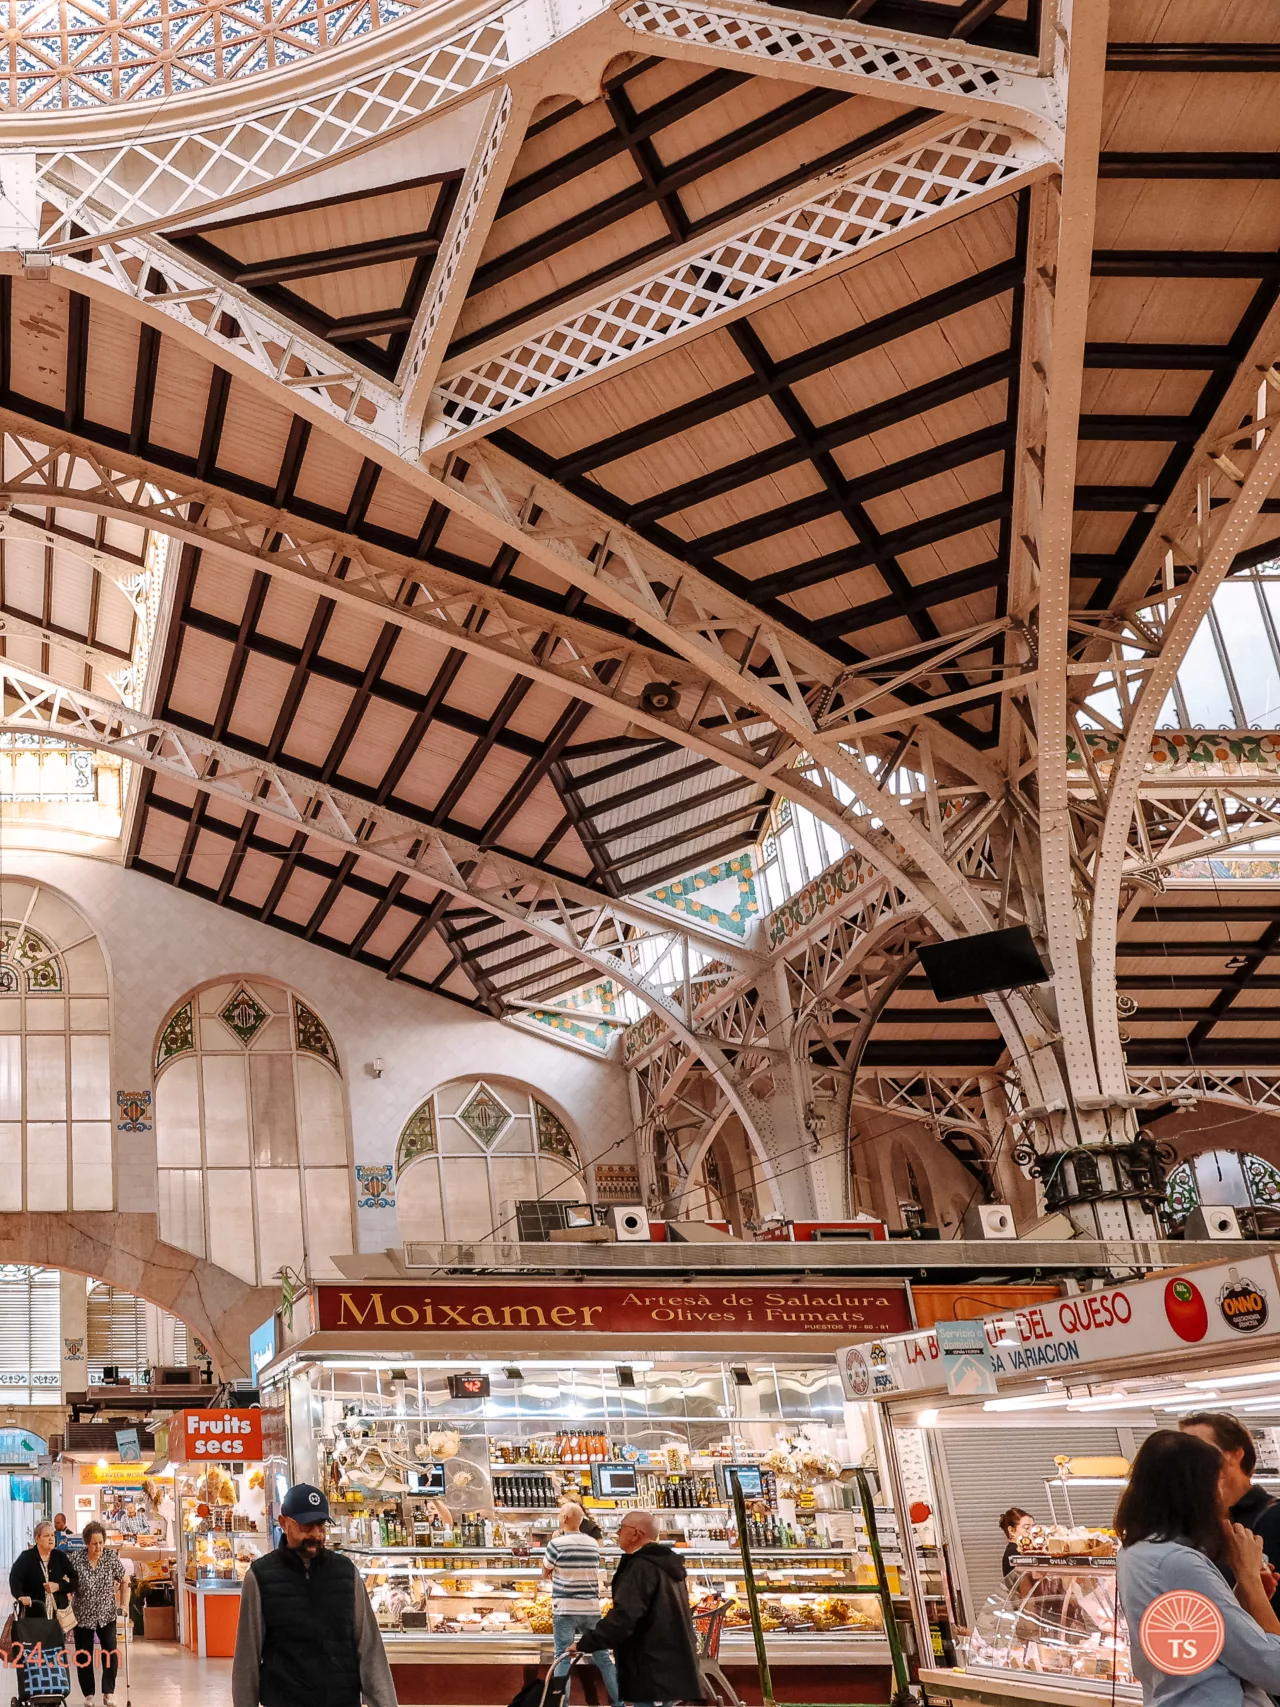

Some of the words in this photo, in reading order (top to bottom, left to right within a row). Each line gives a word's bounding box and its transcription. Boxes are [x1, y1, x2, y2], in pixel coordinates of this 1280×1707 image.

[621, 1293, 712, 1307] Artesà
[722, 1293, 754, 1307] de
[764, 1293, 891, 1307] Saladura
[1223, 1293, 1263, 1316] ONNO
[336, 1293, 603, 1327] Moixamer
[651, 1308, 736, 1322] Olives
[746, 1308, 754, 1321] i
[765, 1308, 865, 1322] Fumats
[1016, 1309, 1054, 1342] DEL
[1058, 1291, 1133, 1335] QUESO
[939, 1328, 976, 1338] Servicio
[943, 1339, 984, 1349] domicilio
[1008, 1340, 1081, 1370] VARIACION
[463, 1380, 481, 1392] 42
[187, 1414, 252, 1434] Fruits
[194, 1439, 244, 1454] secs
